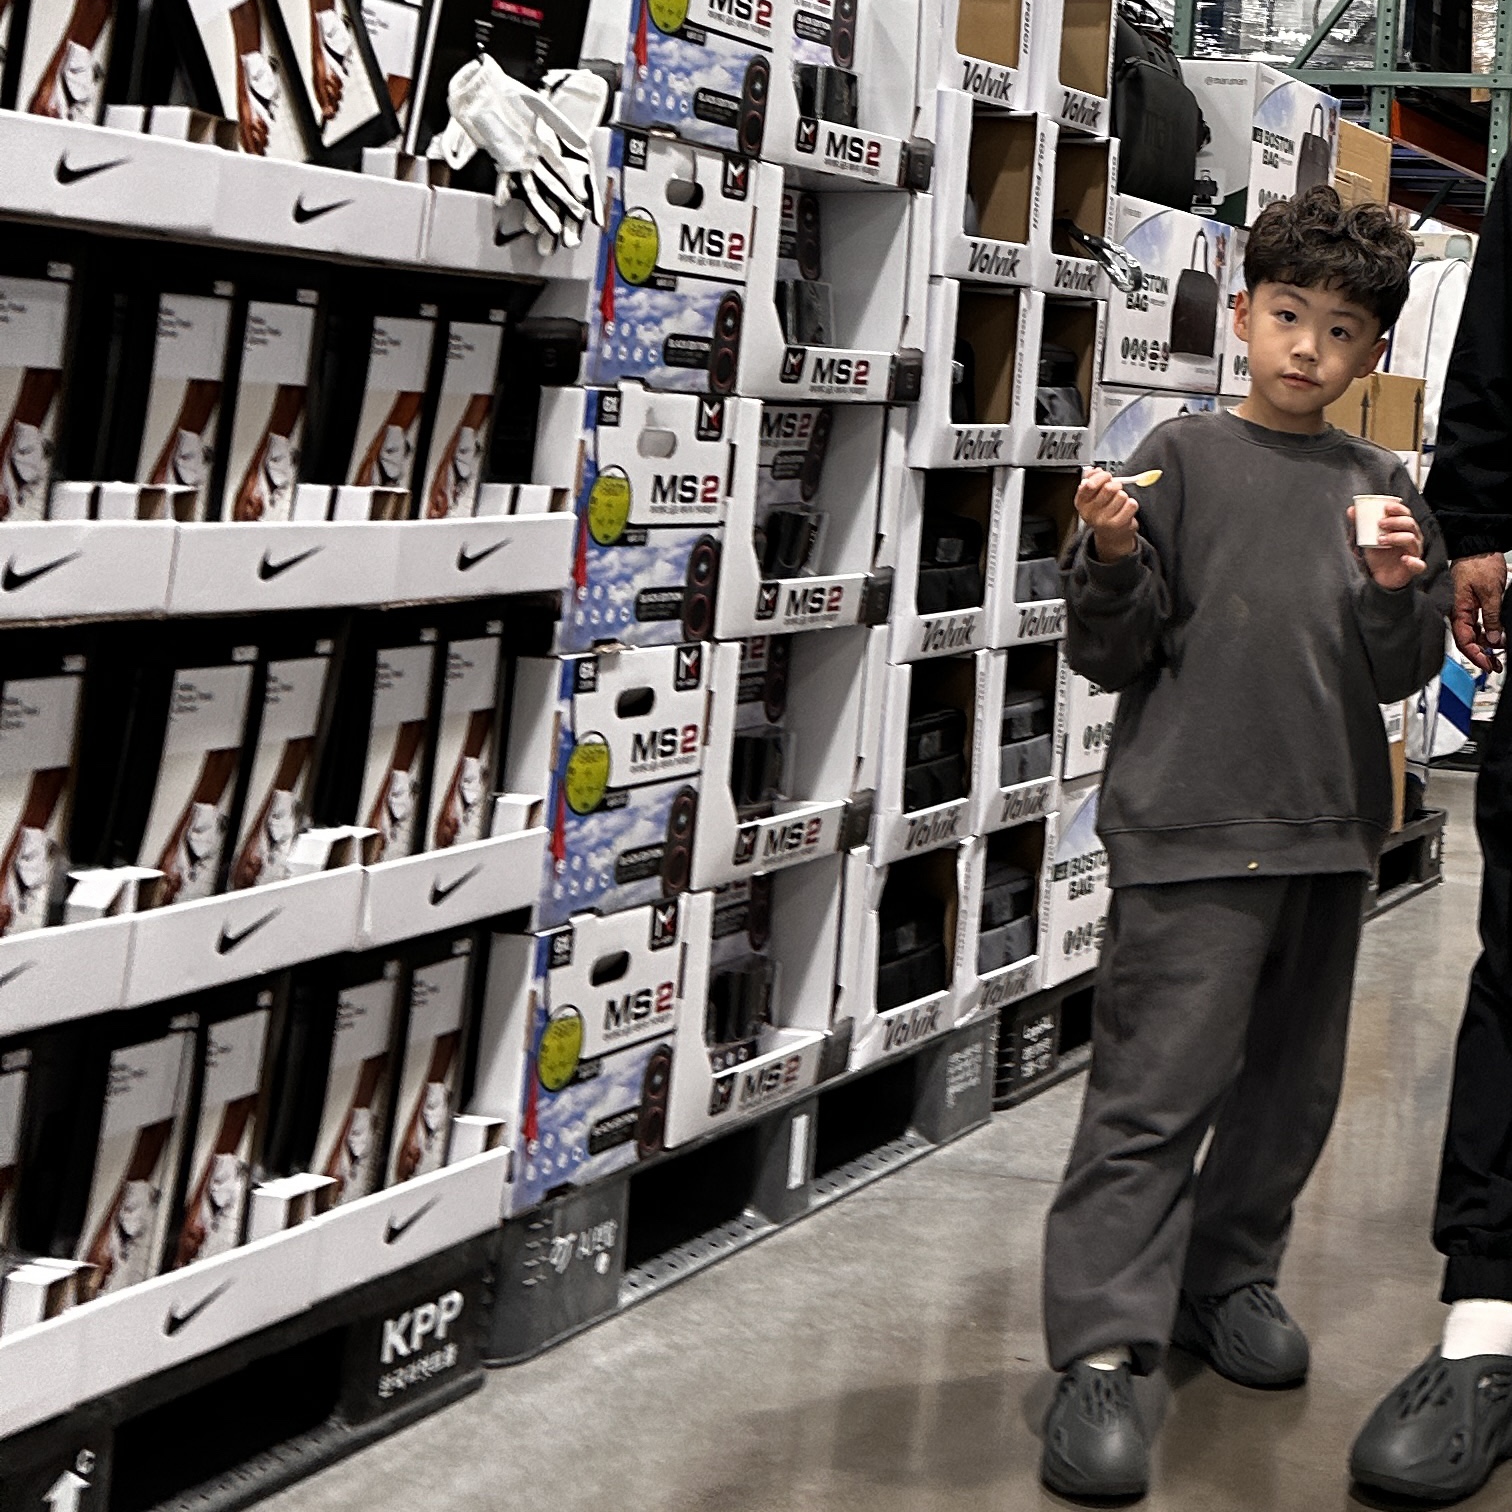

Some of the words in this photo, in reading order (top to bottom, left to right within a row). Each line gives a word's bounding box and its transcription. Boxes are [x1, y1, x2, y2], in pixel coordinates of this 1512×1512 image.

[962, 60, 1013, 101] Volvik
[1060, 91, 1102, 129] Volvik
[825, 131, 881, 167] MS2
[1262, 149, 1280, 169] BAG
[1264, 130, 1295, 156] BOSTON
[679, 223, 745, 261] MS2
[967, 242, 1021, 278] Volvik
[1055, 260, 1097, 291] Volvik
[1126, 293, 1149, 312] BAG
[811, 357, 871, 386] MS2
[761, 412, 813, 438] MS2
[953, 430, 1003, 461] Volvik
[1036, 431, 1083, 461] Volvik
[650, 474, 720, 504] MS2
[784, 586, 844, 617] MS2
[921, 615, 976, 652] Volvik
[1017, 606, 1067, 639] Volvik
[630, 723, 698, 763] MS2
[762, 817, 823, 857] MS2
[603, 981, 675, 1031] MS2
[738, 1054, 802, 1102] MS2
[380, 1290, 464, 1364] KPP
